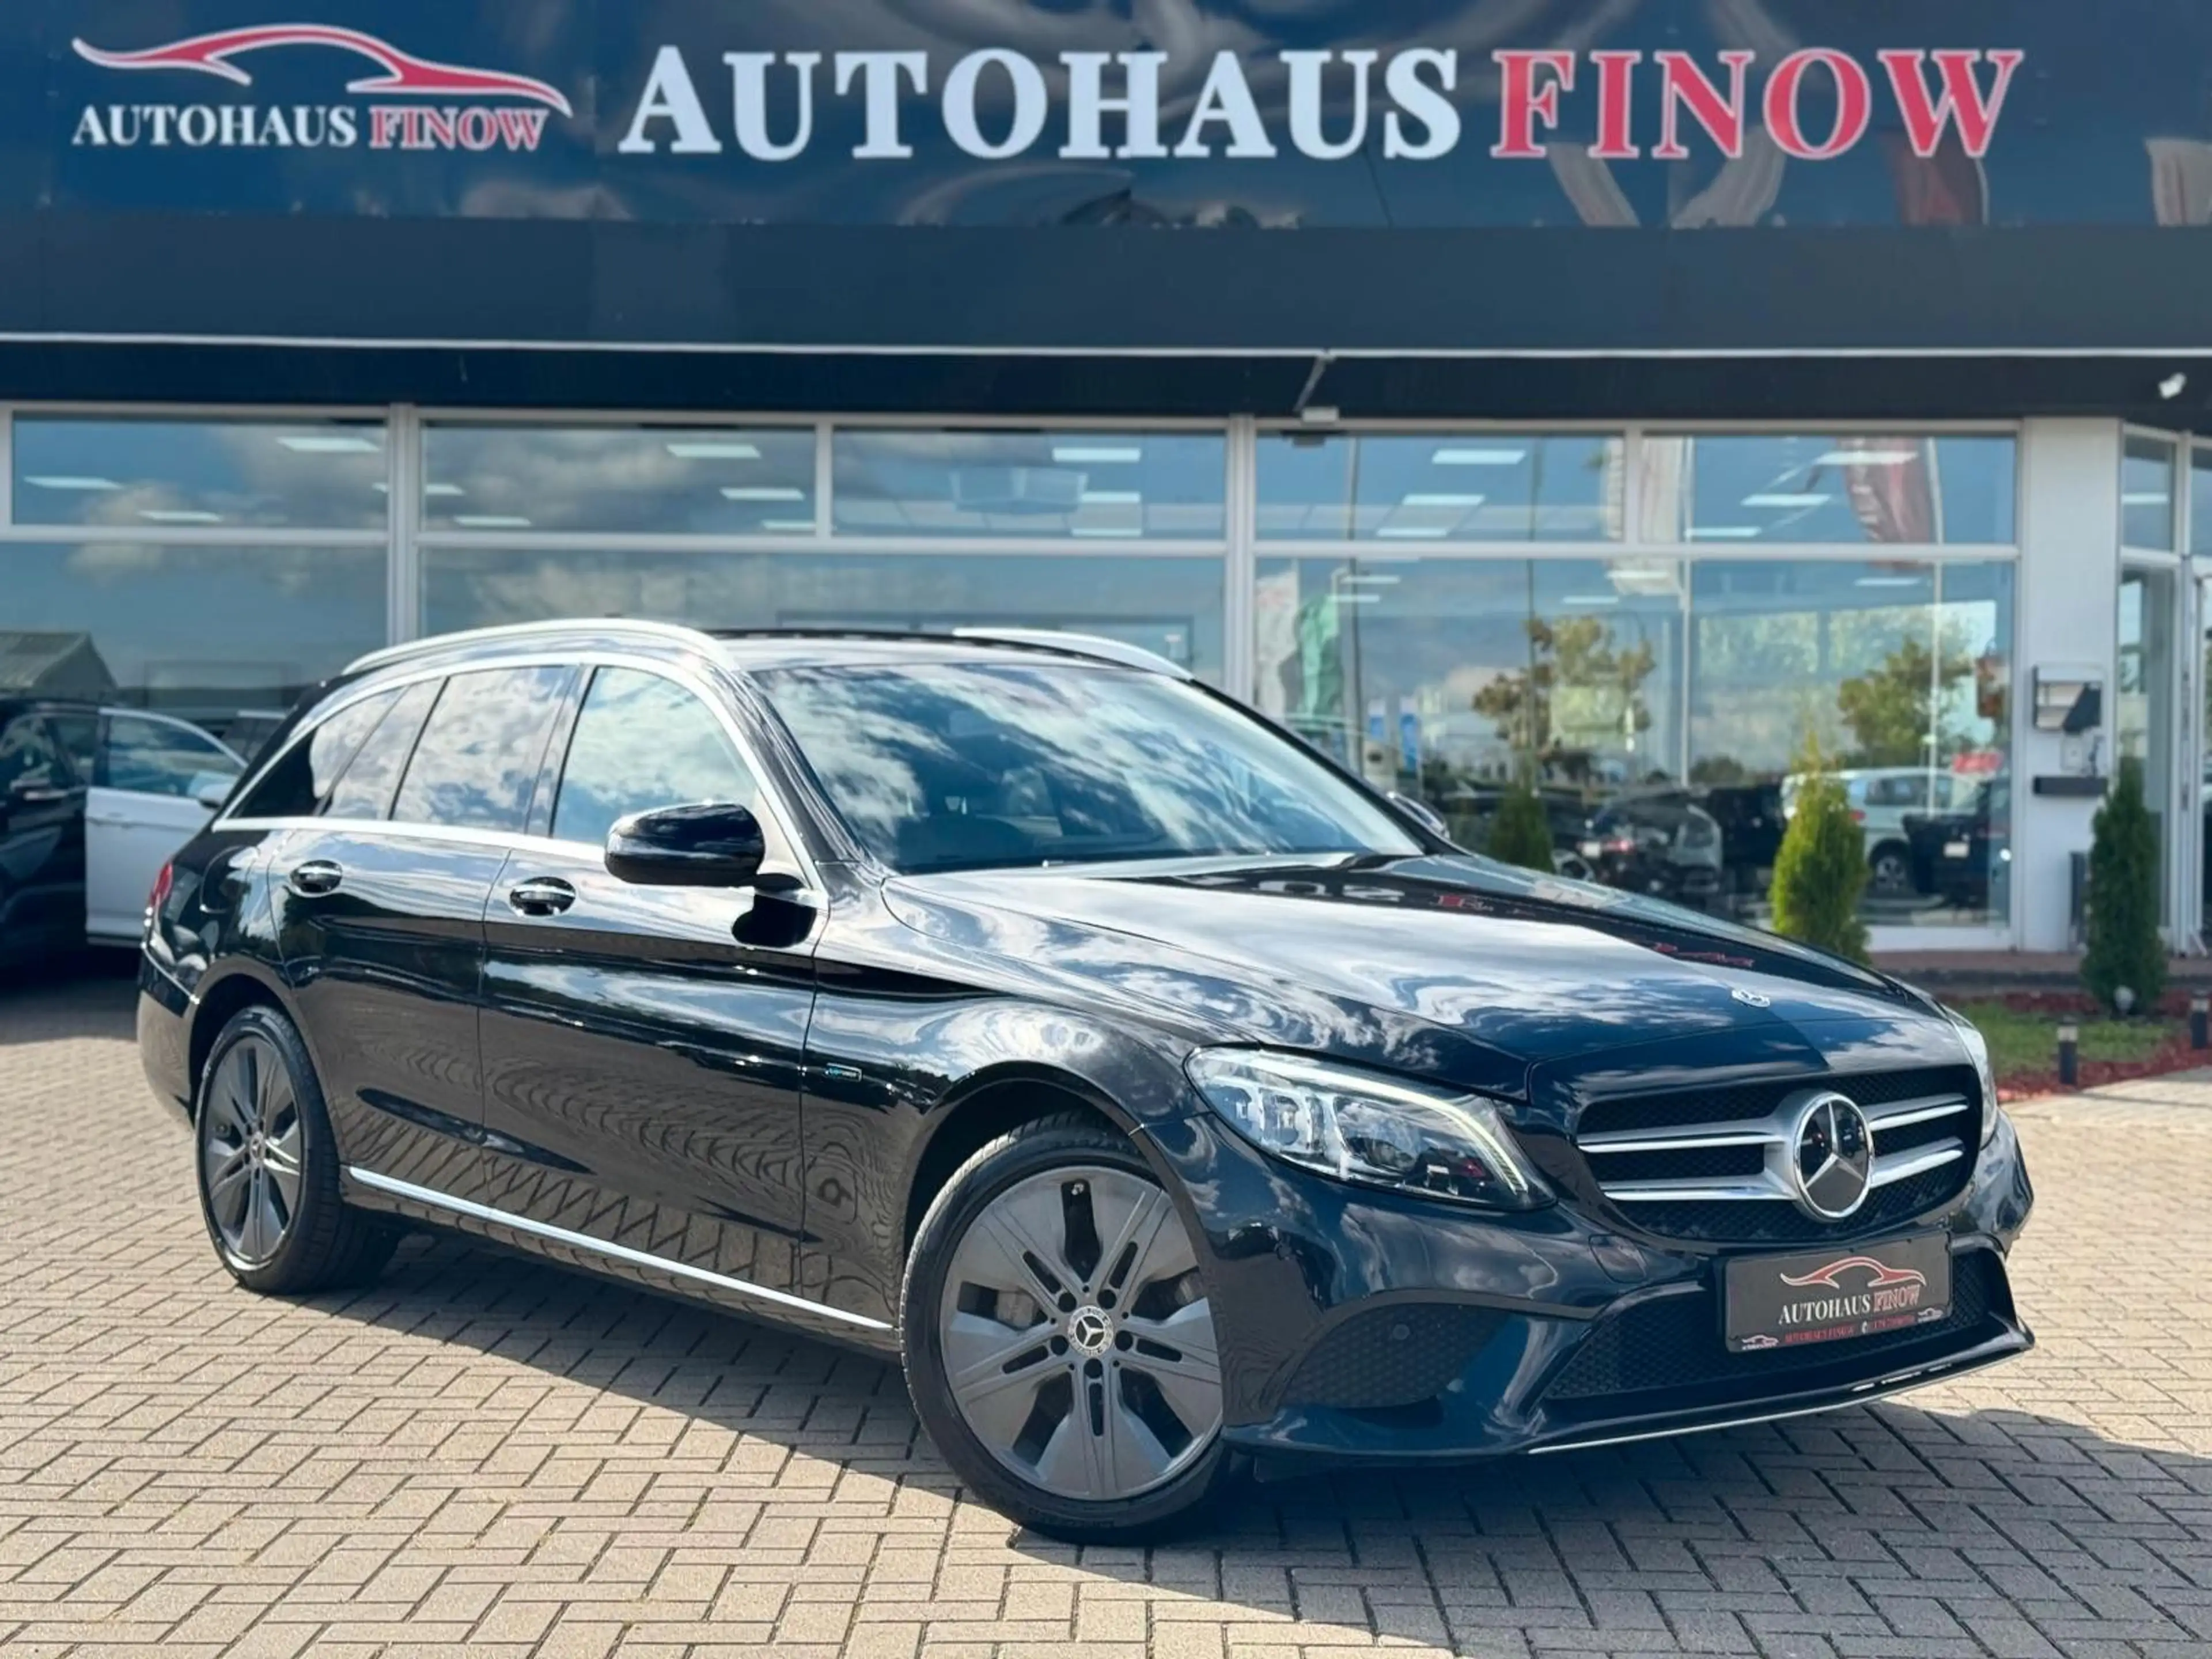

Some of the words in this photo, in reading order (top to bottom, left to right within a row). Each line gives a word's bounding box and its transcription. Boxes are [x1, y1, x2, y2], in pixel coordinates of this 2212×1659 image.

[618, 45, 1460, 161] AUTOHAUS
[1491, 47, 2025, 160] FINOW
[71, 105, 357, 147] AUTOHAUS
[369, 105, 549, 151] FINOW
[1778, 1294, 1870, 1325] AUTOHAUS
[1873, 1284, 1921, 1313] FINOW
